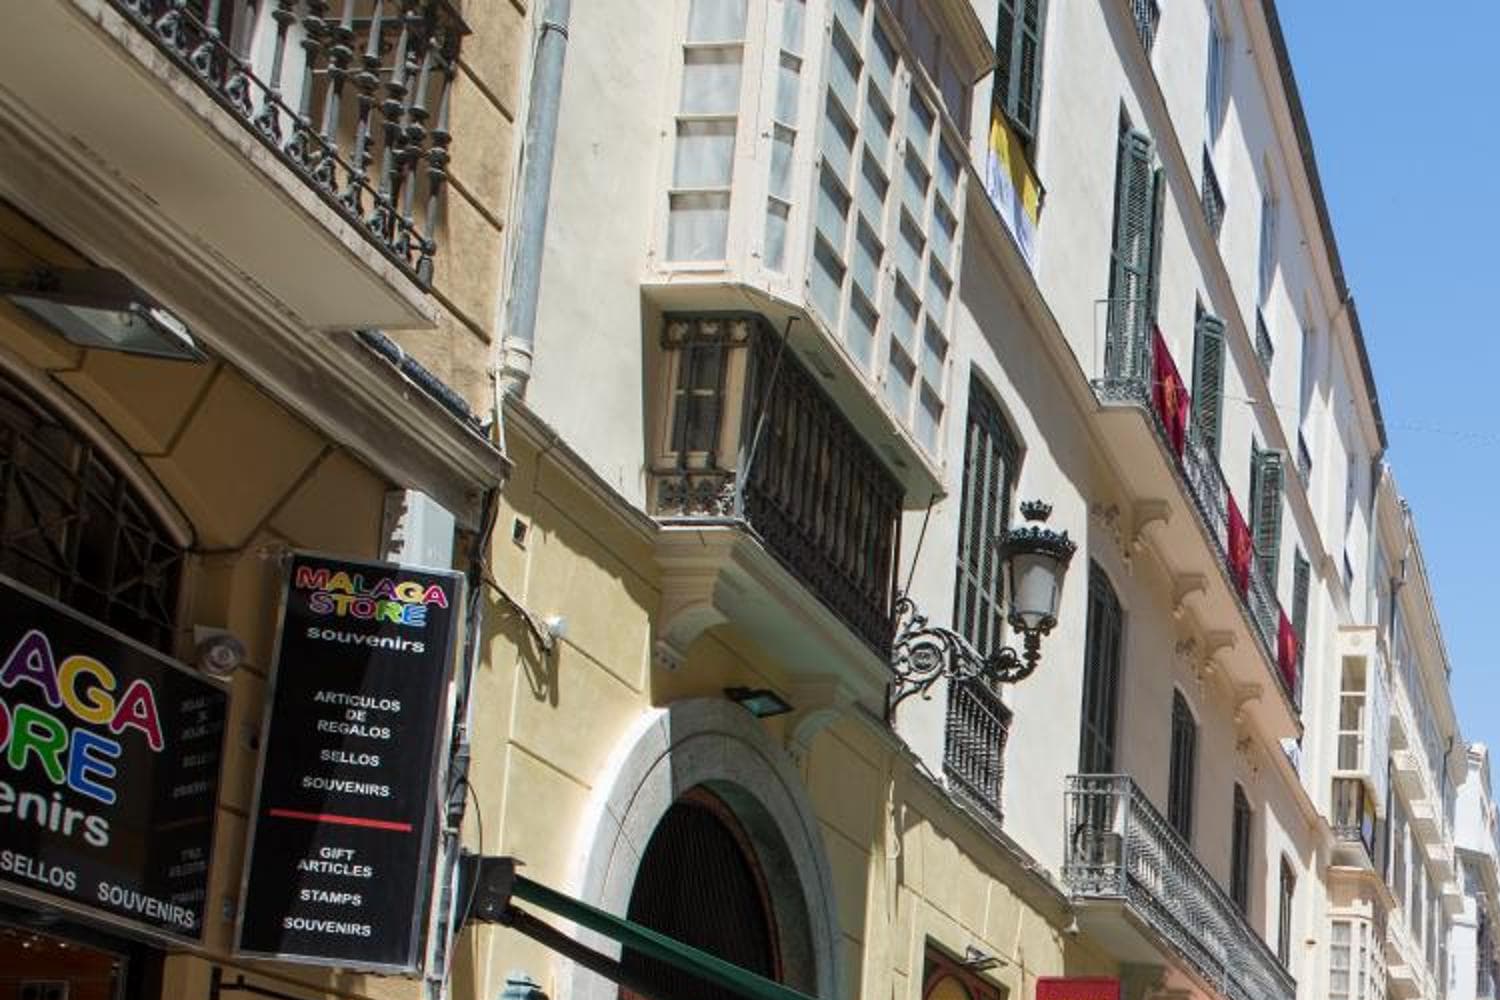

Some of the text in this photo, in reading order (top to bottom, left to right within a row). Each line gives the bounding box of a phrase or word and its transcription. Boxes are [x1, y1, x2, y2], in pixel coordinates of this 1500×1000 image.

[296, 565, 448, 609] MALAGA
[309, 590, 428, 627] STORE
[307, 626, 425, 653] souvenirs
[314, 691, 400, 712] ARTICULOS
[345, 709, 367, 722] DE
[317, 719, 391, 739] REGALOS
[0, 696, 122, 805] RE
[320, 749, 380, 767] SELLOS
[303, 776, 390, 797] SOUVENIRS
[320, 847, 355, 861] GIFT
[298, 859, 373, 878] ARTICLES
[0, 849, 195, 928] SELLOS SOUVENIRS
[300, 889, 362, 906] STAMPS
[283, 917, 371, 937] SOUVENIRS
